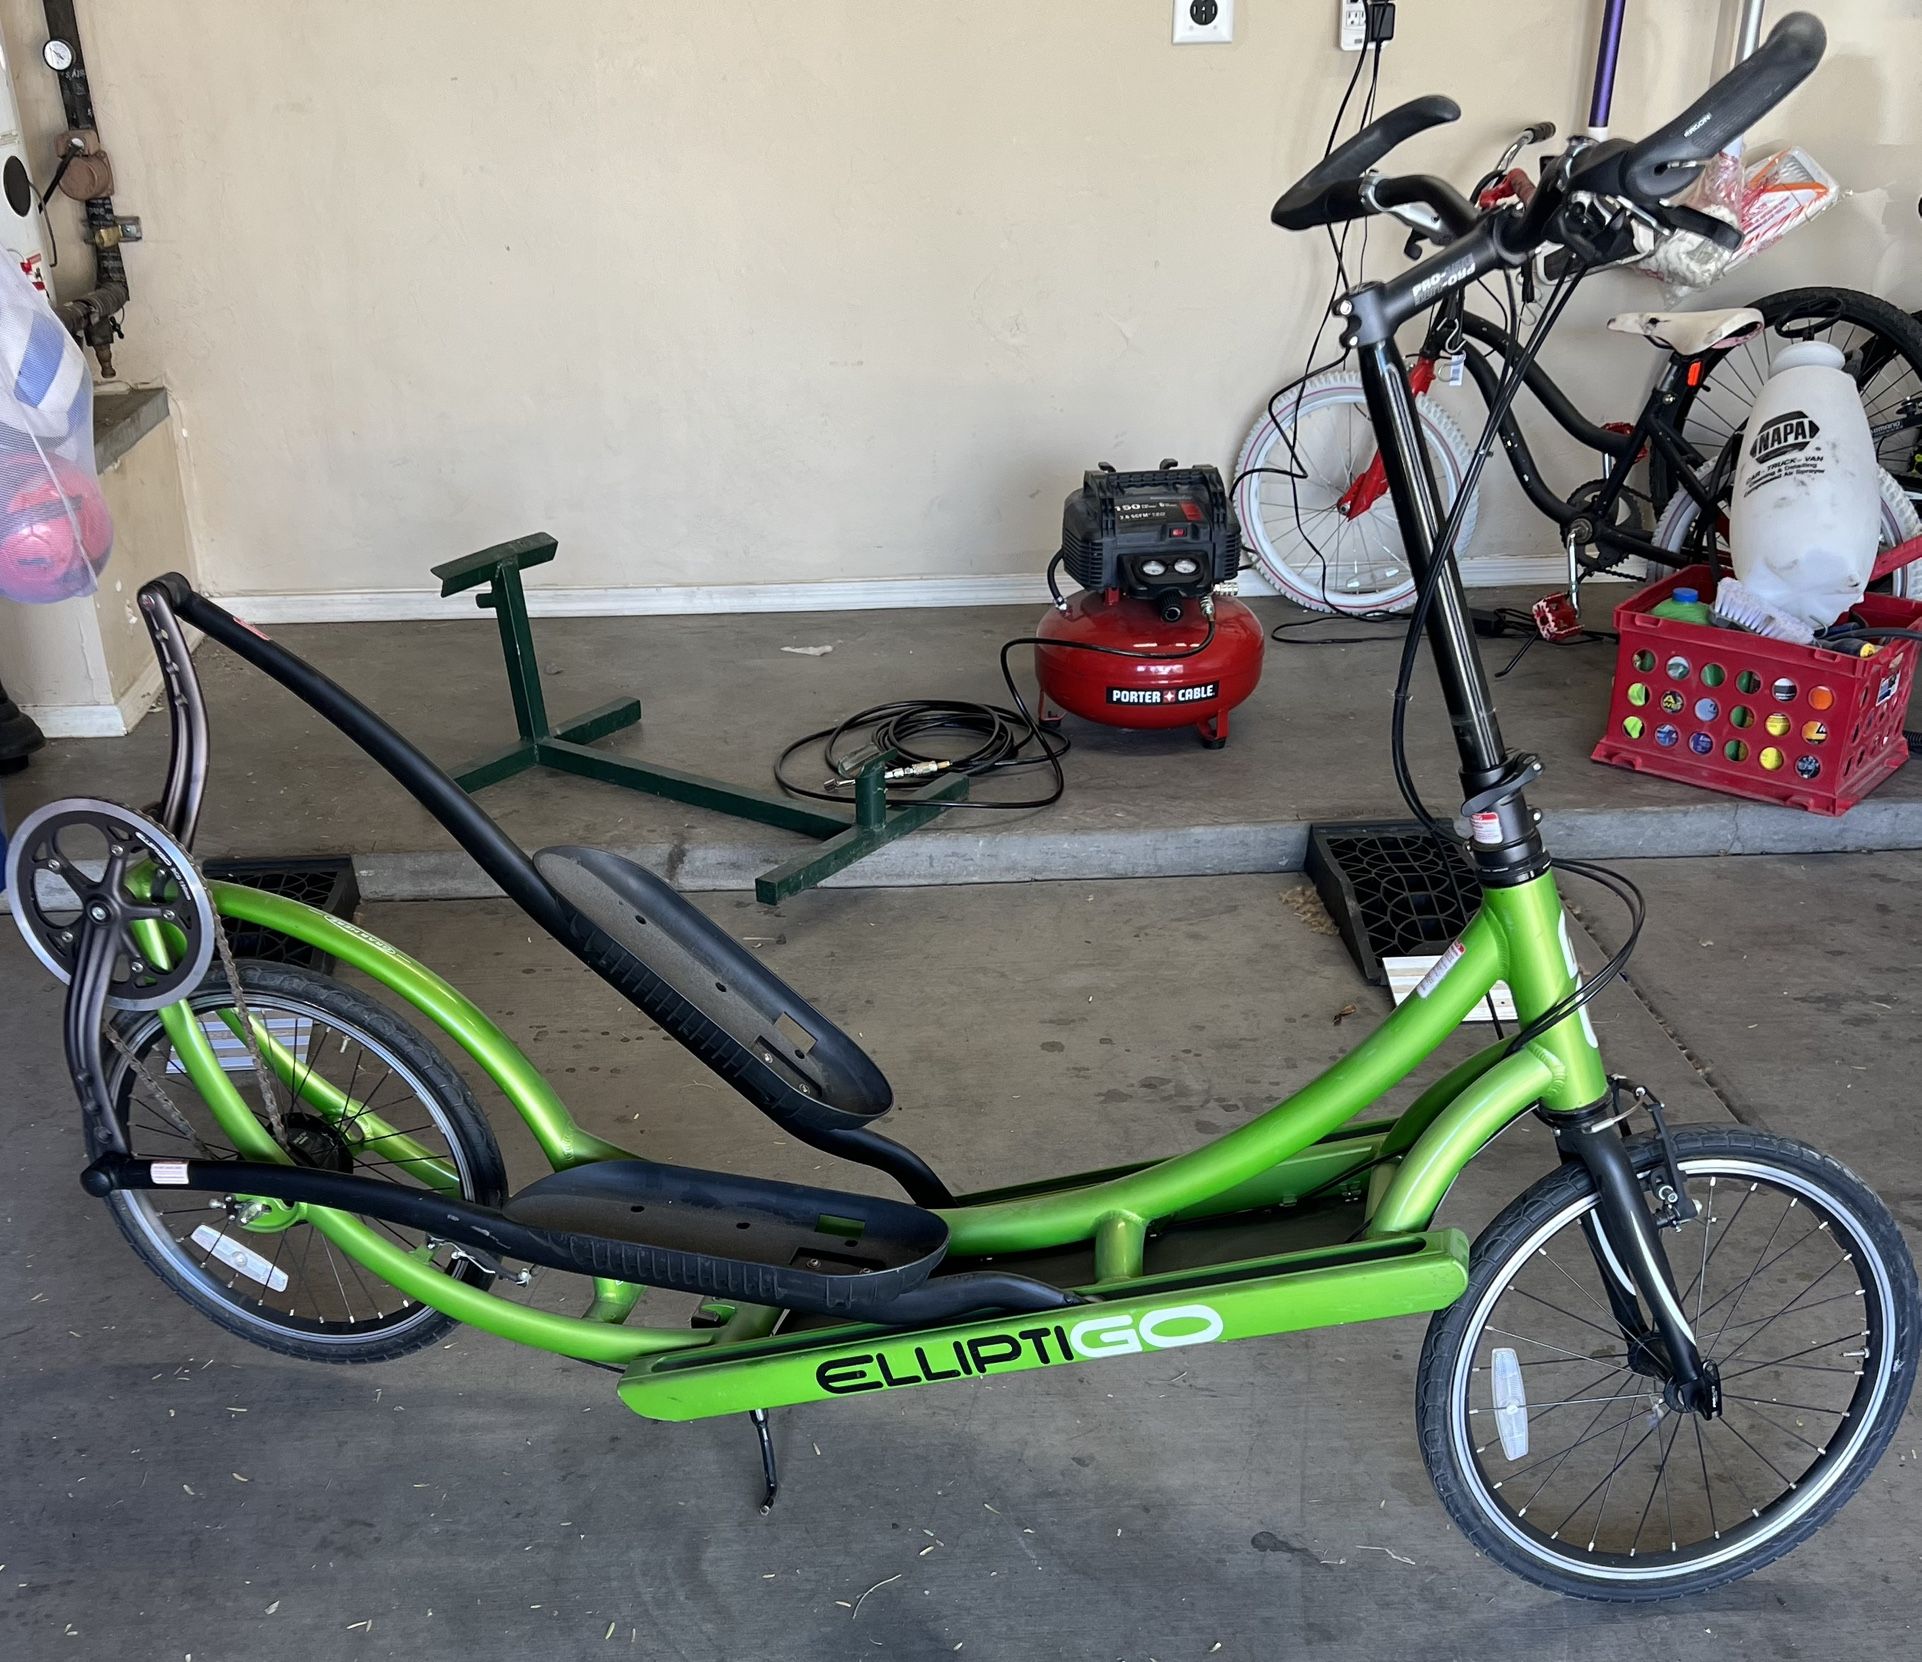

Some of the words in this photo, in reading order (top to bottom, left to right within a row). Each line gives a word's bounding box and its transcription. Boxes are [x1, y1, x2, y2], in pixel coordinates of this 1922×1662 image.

[1683, 111, 1712, 138] ERGON
[1758, 420, 1807, 455] NAPA
[1766, 458, 1797, 471] TRUCK
[1112, 689, 1161, 703] PORTER
[1177, 684, 1214, 701] CABLE
[815, 1303, 1224, 1395] ELLIPTIGO
